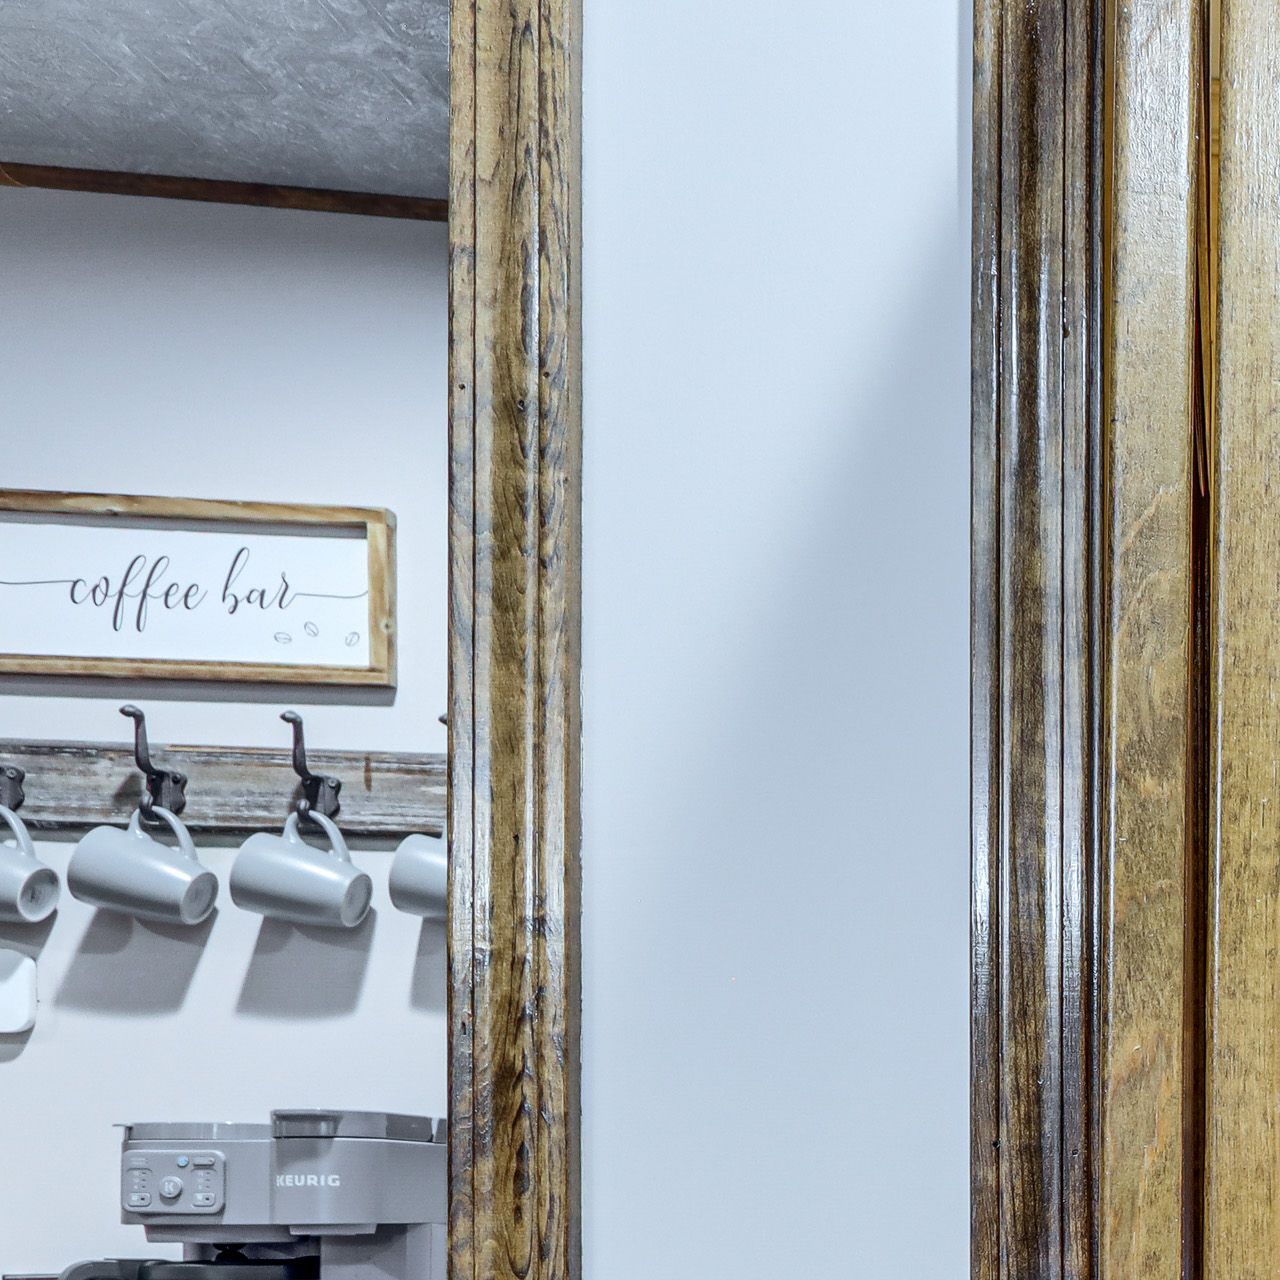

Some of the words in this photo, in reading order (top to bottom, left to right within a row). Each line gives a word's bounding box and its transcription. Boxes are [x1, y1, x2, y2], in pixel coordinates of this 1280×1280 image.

[70, 554, 207, 632] coffee
[222, 547, 299, 615] bar
[164, 1181, 174, 1192] K
[276, 1174, 340, 1187] KEURIG
